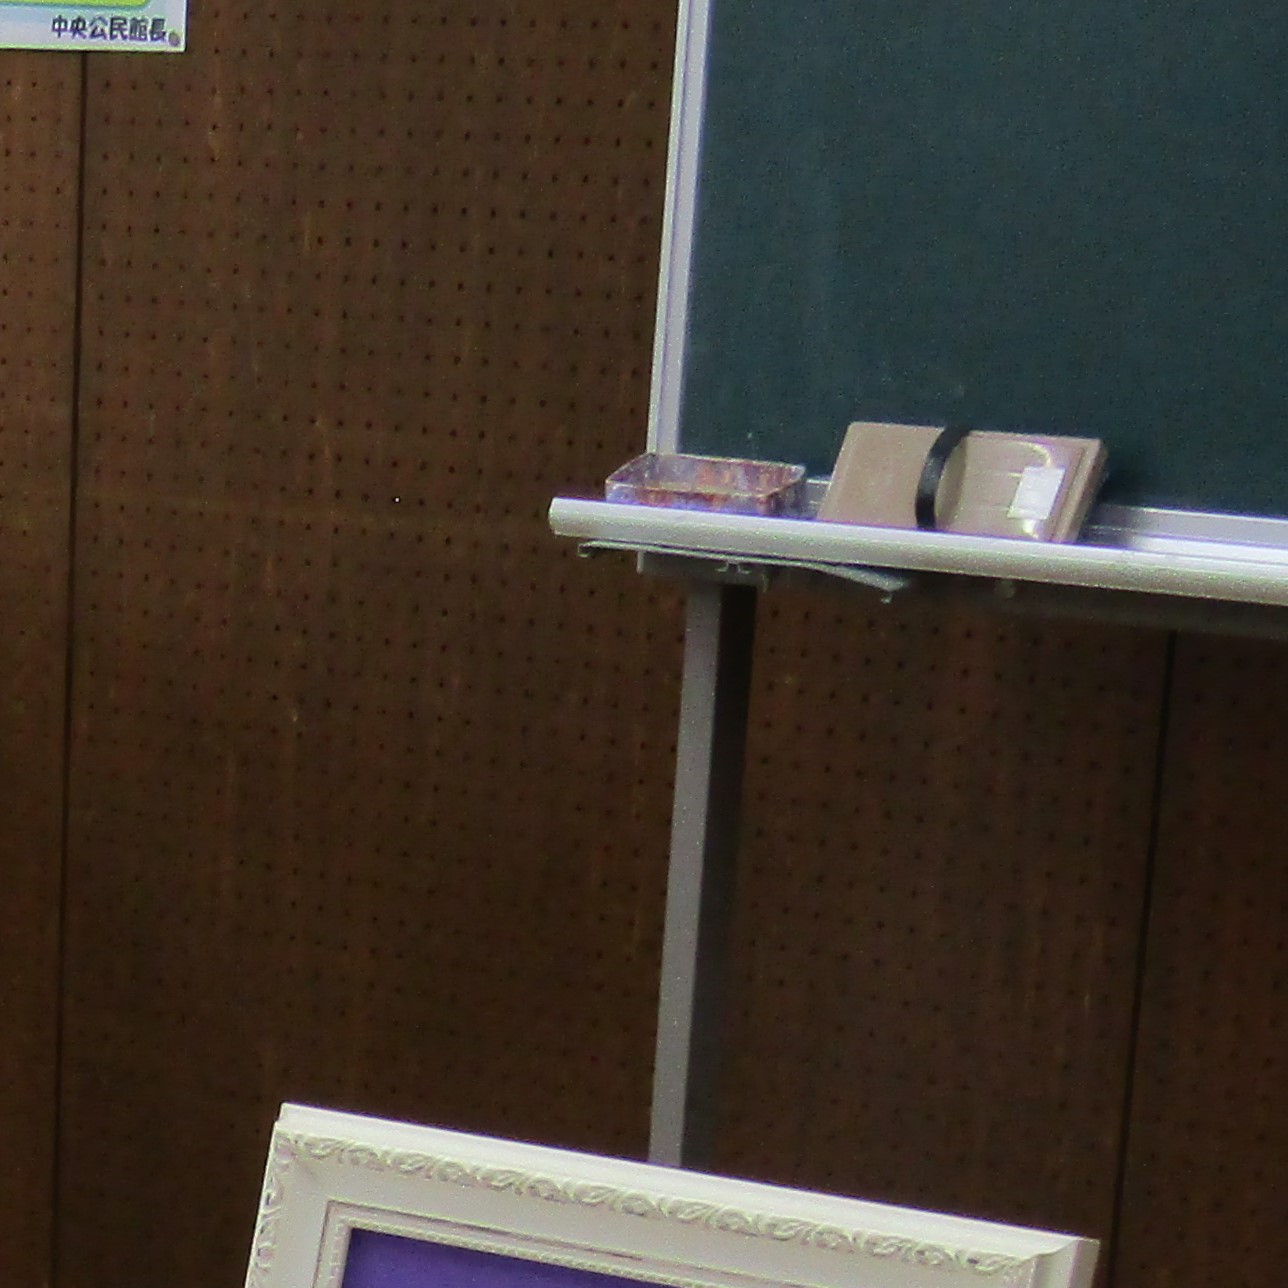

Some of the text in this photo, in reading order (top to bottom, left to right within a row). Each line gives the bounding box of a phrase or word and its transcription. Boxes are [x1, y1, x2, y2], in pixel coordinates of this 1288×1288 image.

[51, 14, 167, 43] 中央公民館長
